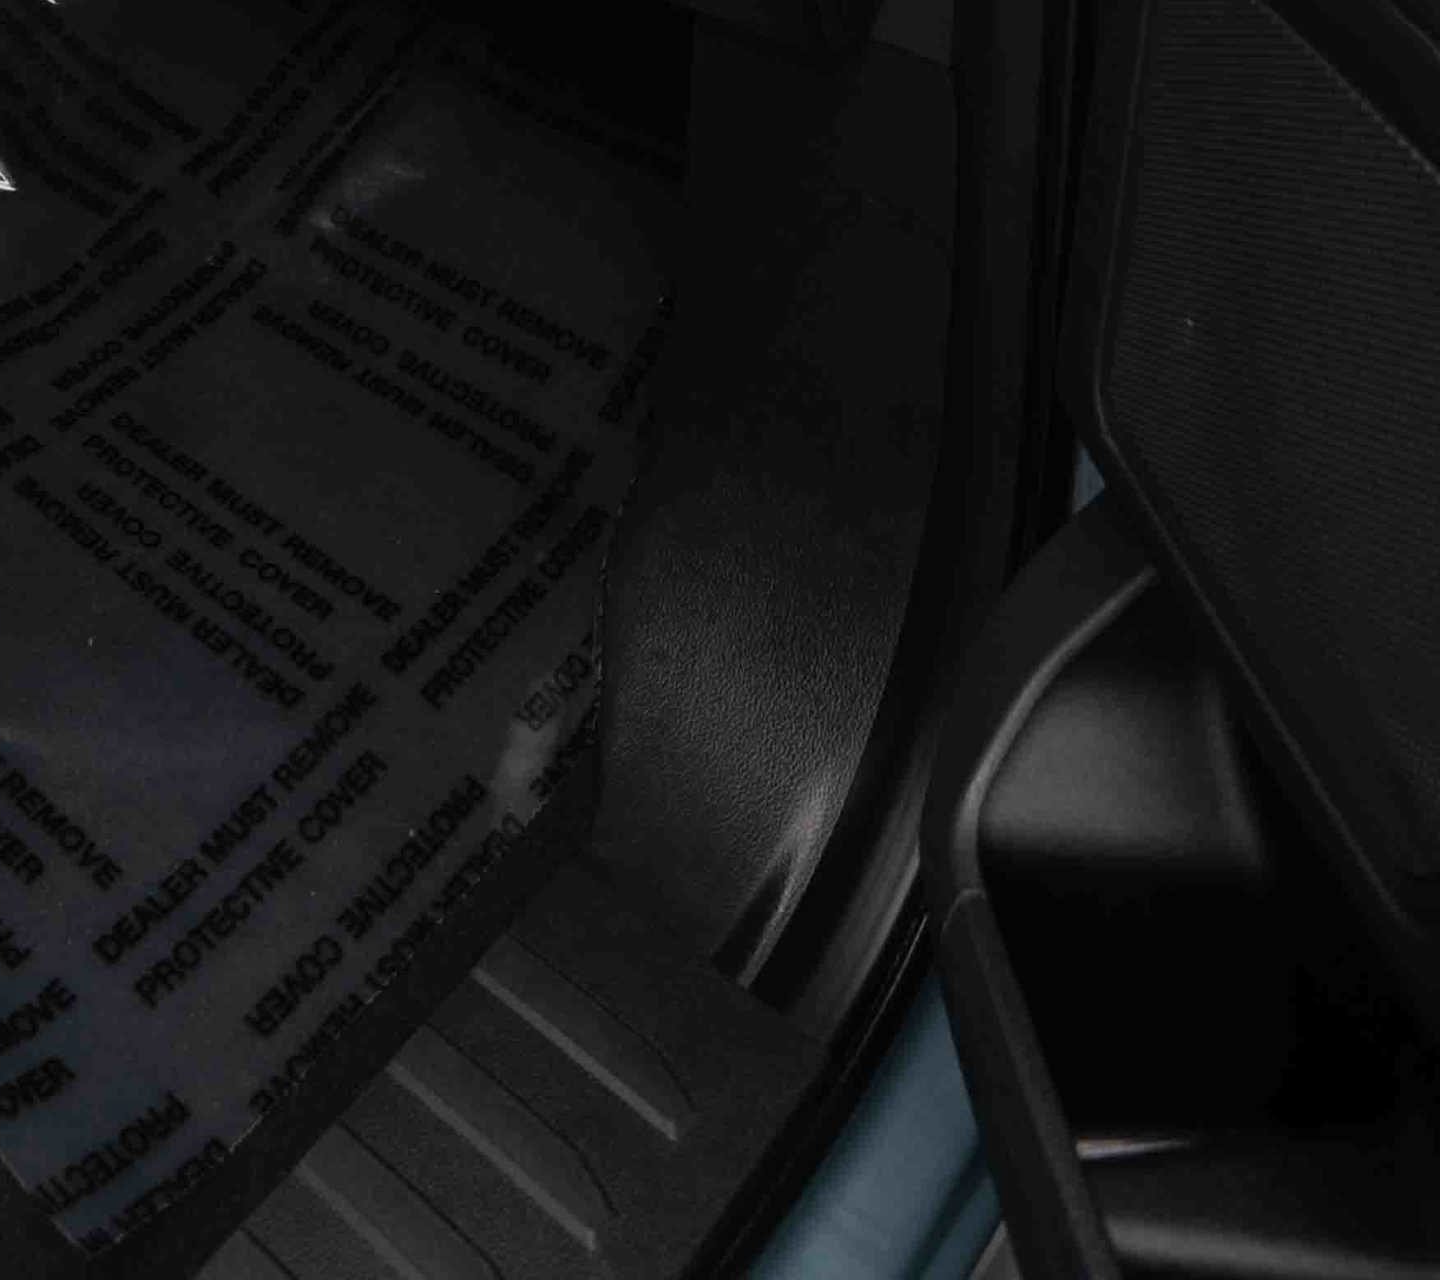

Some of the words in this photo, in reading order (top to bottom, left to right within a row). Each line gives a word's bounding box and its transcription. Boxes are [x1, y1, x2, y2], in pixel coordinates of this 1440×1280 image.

[308, 299, 391, 356] COVER
[310, 235, 458, 332] PROTECTIVE
[463, 326, 552, 386] COVER
[332, 205, 424, 269] DEALER
[425, 260, 498, 307] MUST
[497, 297, 612, 371] REMOVE
[396, 348, 556, 452] PROTECTIVE
[14, 475, 119, 562] REMOVE
[77, 482, 162, 547] COVER
[82, 434, 234, 547] PROTECTIVE
[239, 548, 333, 621] COVER
[110, 412, 208, 482] DEALER
[206, 477, 286, 536] MUST
[282, 531, 403, 622] REMOVE
[115, 562, 196, 622] MUST
[166, 548, 334, 681] PROTECTIVE
[191, 617, 305, 708] DEALER
[93, 857, 209, 965] DEALER
[198, 783, 280, 863] MUST
[271, 682, 378, 792] REMOVE
[132, 838, 305, 1011] PROTECTIVE
[298, 749, 388, 843] COVER
[337, 774, 488, 939] PROTECTIVE
[244, 935, 343, 1036] COVER
